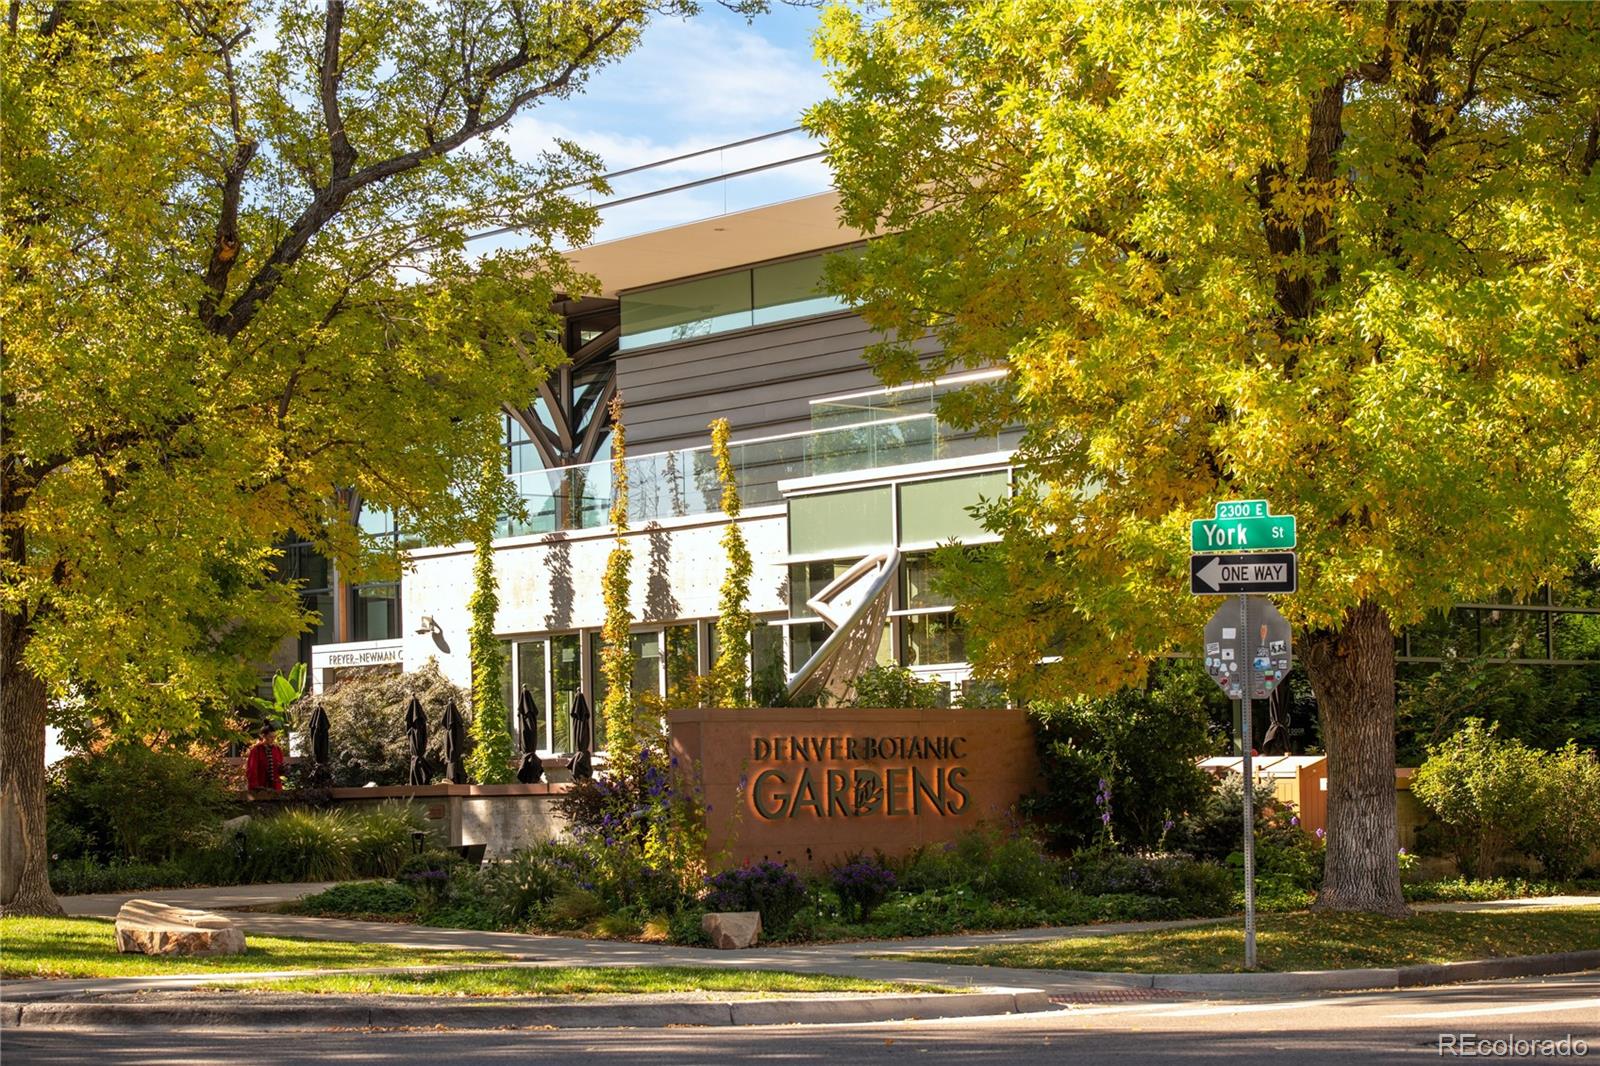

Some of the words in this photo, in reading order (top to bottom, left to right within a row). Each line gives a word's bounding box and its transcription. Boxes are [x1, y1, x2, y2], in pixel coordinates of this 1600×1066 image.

[1220, 504, 1250, 518] 2300
[1255, 503, 1264, 516] E
[1203, 523, 1248, 547] York
[1271, 526, 1284, 539] St
[1221, 566, 1249, 581] ONE
[1254, 565, 1283, 581] WAY
[329, 652, 395, 665] FREYER-NEWMAN
[754, 736, 861, 761] DENVER
[863, 735, 967, 760] BOTANIC
[752, 766, 971, 820] GARDENS
